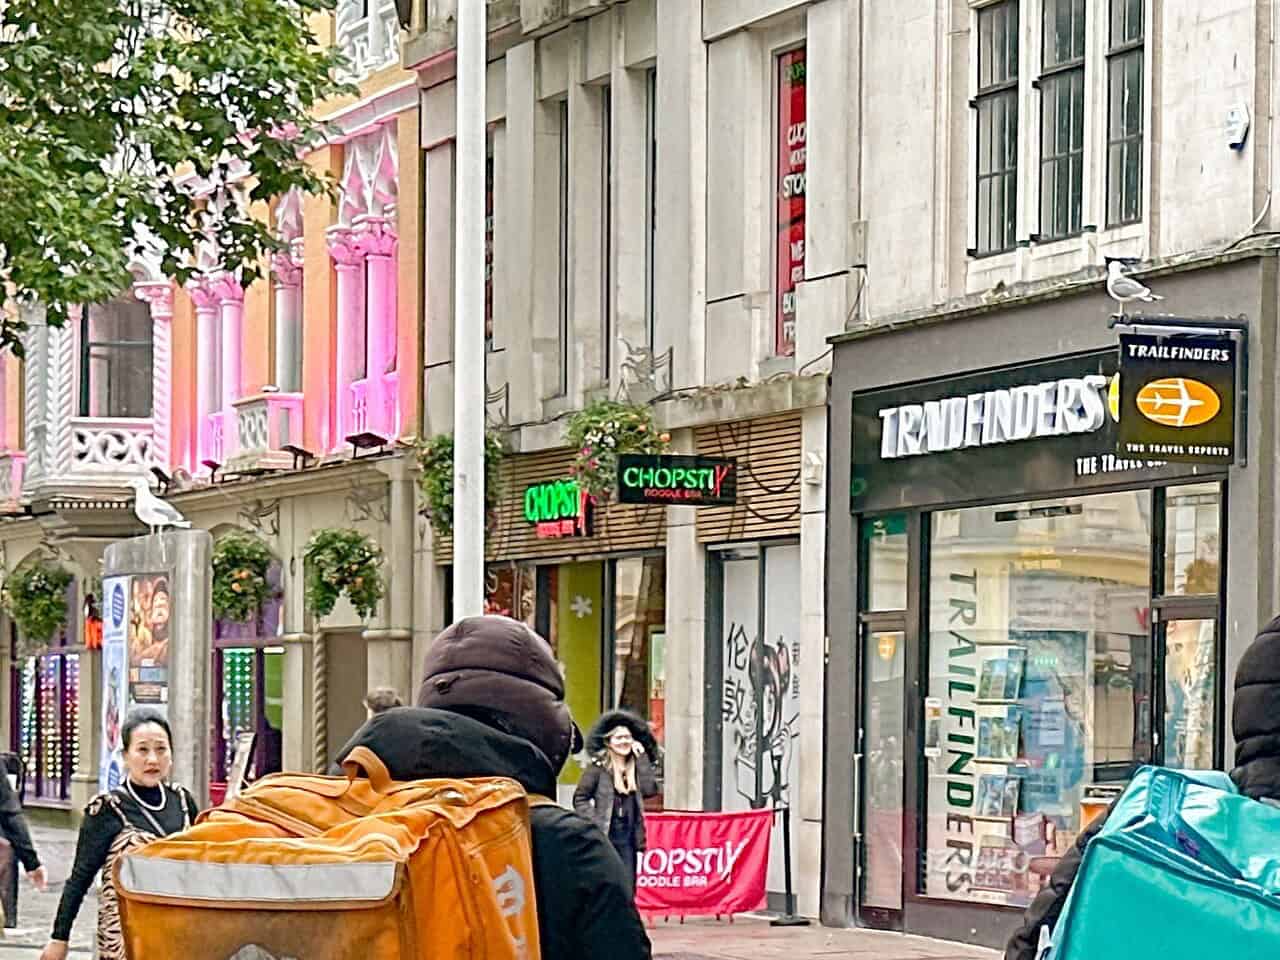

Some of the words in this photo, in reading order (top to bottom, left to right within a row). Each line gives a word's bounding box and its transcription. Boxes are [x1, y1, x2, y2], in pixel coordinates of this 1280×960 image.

[1128, 344, 1230, 362] TRAILFINDERS
[879, 374, 1106, 459] TRAILFINDERS
[1126, 443, 1145, 452] THE
[1150, 444, 1185, 454] TRAVEL
[1076, 456, 1097, 475] THE
[945, 568, 977, 893] TRAILFINDERS
[636, 838, 749, 884] OPSTIX
[637, 875, 681, 888] OODLE
